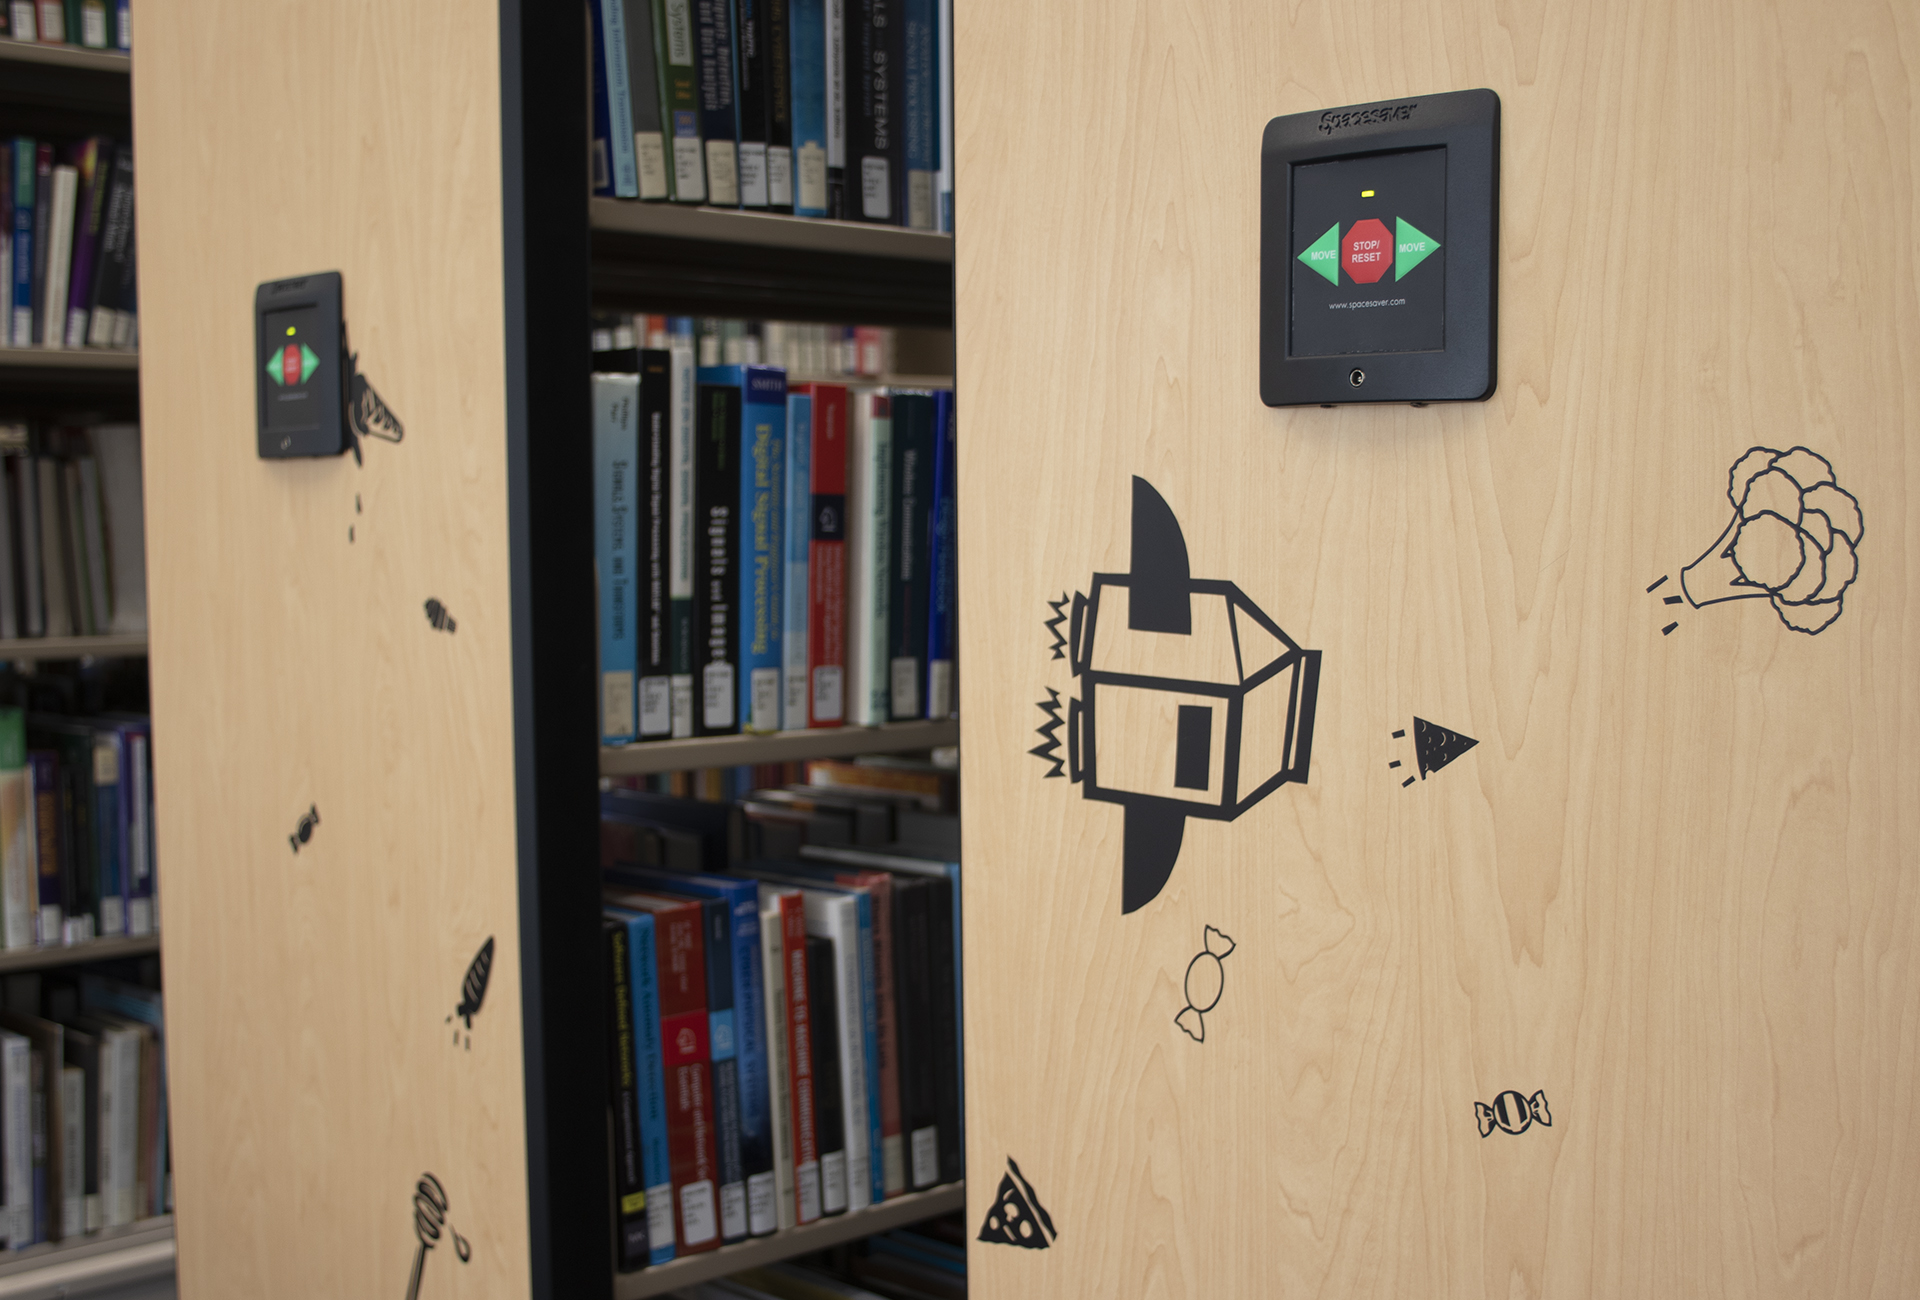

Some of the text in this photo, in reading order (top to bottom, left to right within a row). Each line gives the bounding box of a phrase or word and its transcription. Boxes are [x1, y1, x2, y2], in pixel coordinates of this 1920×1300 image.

[667, 3, 688, 58] Systems
[873, 50, 890, 150] SYSTEMS
[1319, 103, 1417, 135] Spacesaver
[1353, 239, 1380, 252] STOP/
[1398, 241, 1426, 254] MOVE
[1311, 249, 1337, 262] MOVE
[1351, 252, 1381, 264] RESET
[1328, 297, 1406, 310] www.spacesaver.com
[751, 377, 784, 393] SMITH
[707, 505, 729, 577] Signals
[751, 424, 772, 655] Digital Signal Processing
